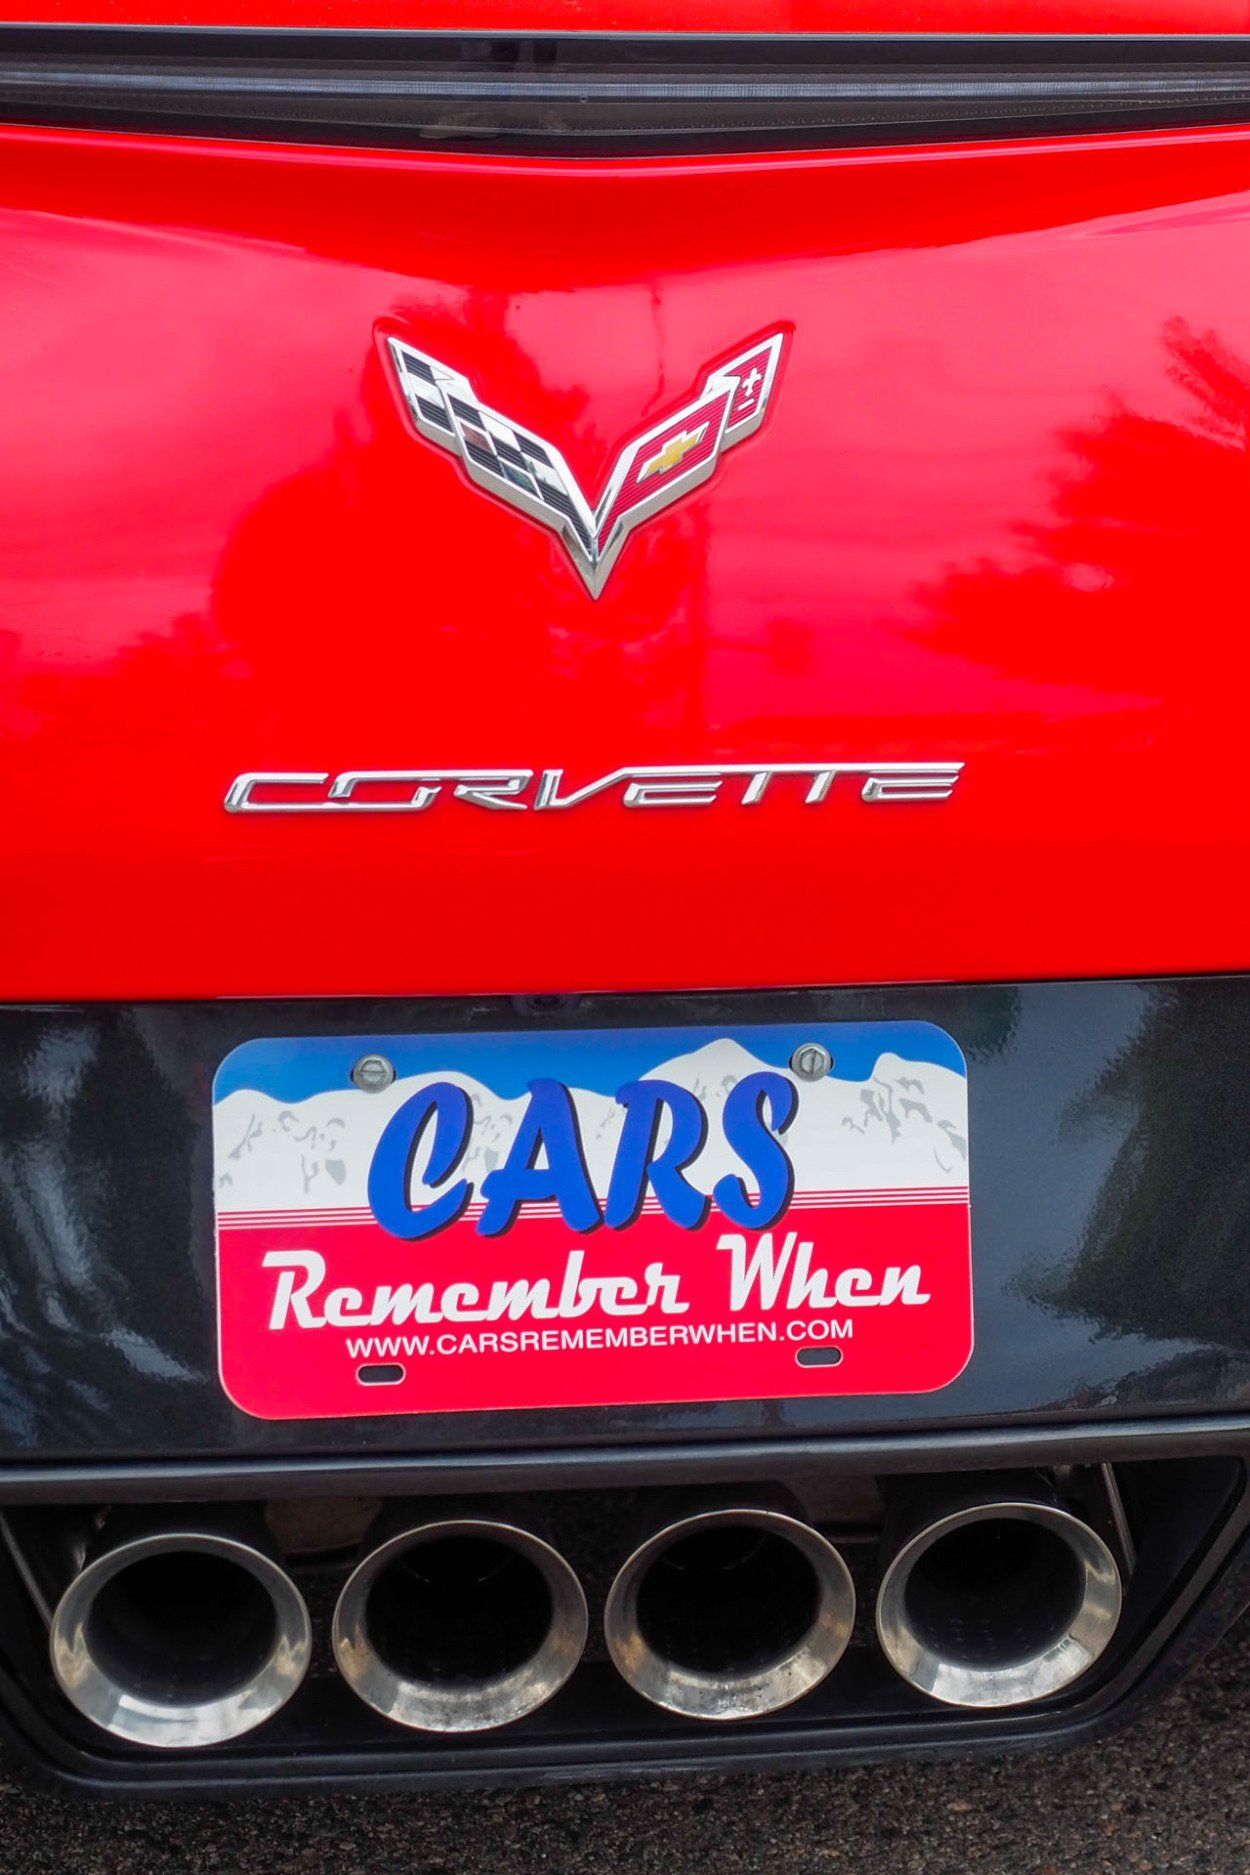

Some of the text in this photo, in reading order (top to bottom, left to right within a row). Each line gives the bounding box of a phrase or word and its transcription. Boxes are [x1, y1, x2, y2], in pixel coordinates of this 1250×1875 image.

[224, 761, 965, 813] CORVETTE
[367, 1072, 799, 1240] CARS
[262, 1232, 931, 1330] Remember When
[346, 1319, 854, 1358] WWW.CARSREMEMBERWHEN.COM
